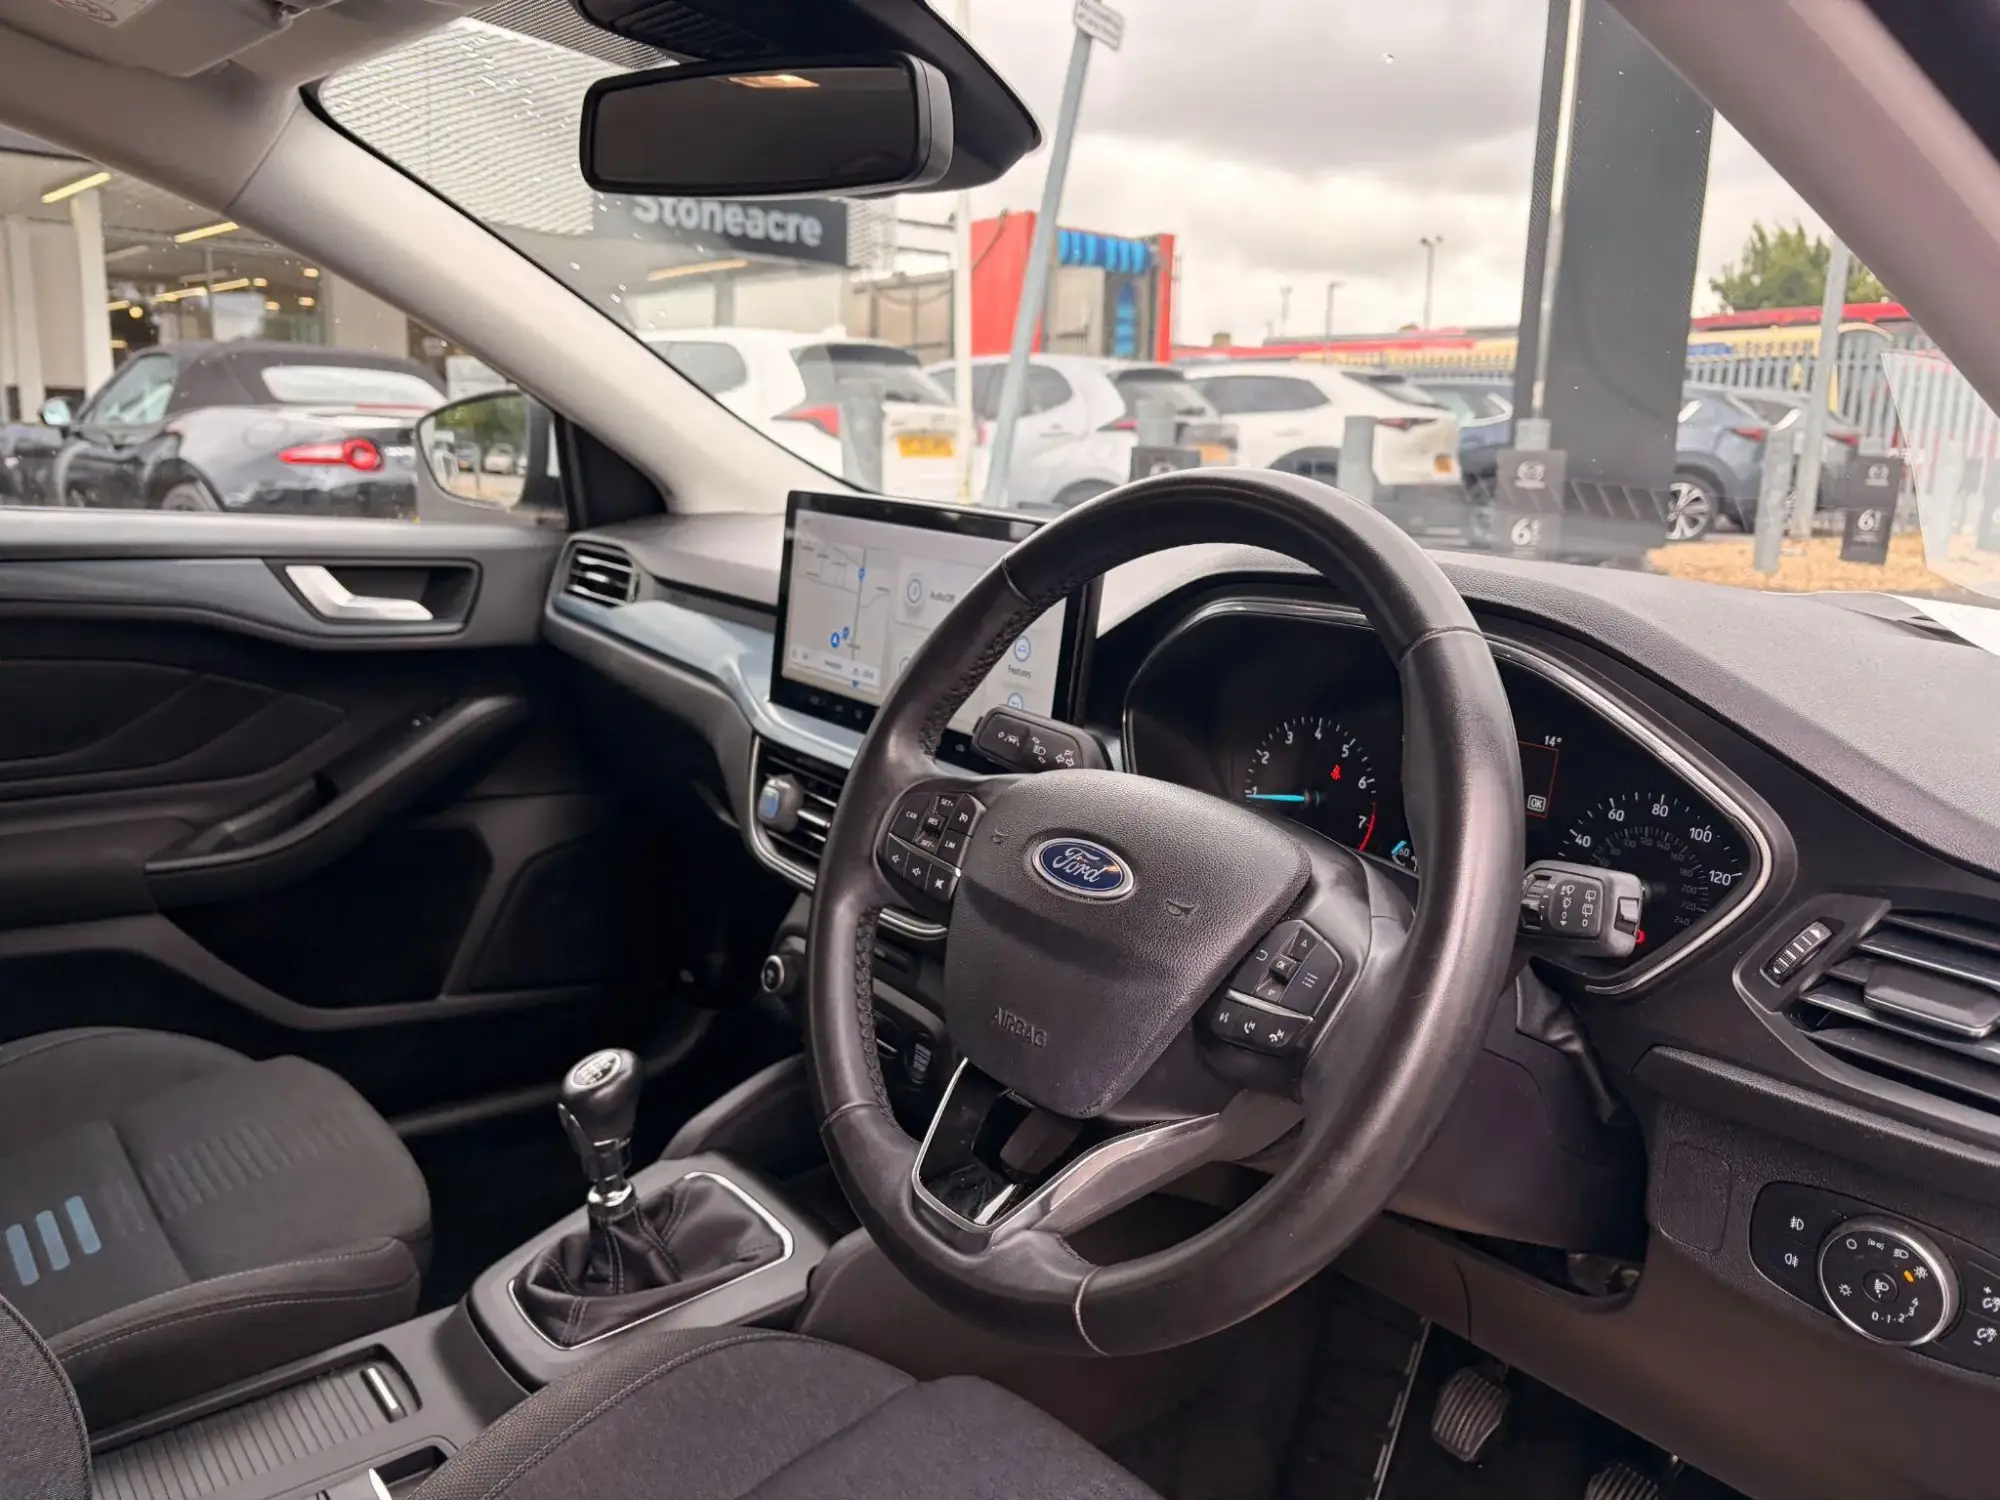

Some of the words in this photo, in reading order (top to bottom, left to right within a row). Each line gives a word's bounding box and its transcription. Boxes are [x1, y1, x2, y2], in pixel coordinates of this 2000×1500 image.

[633, 196, 823, 247] Stoneacre
[1285, 731, 1293, 744] 3
[1314, 727, 1322, 741] 4
[1261, 751, 1270, 764] 2
[1341, 744, 1350, 758] 5
[1358, 776, 1367, 789] 6
[1530, 798, 1543, 809] OK
[906, 811, 918, 820] CAN
[1608, 809, 1625, 822] 60
[1651, 804, 1669, 817] 80
[1358, 815, 1367, 829] 7
[1574, 835, 1592, 848] 40
[1689, 827, 1712, 843] 100
[1052, 846, 1107, 884] Ford
[1708, 869, 1732, 887] 120
